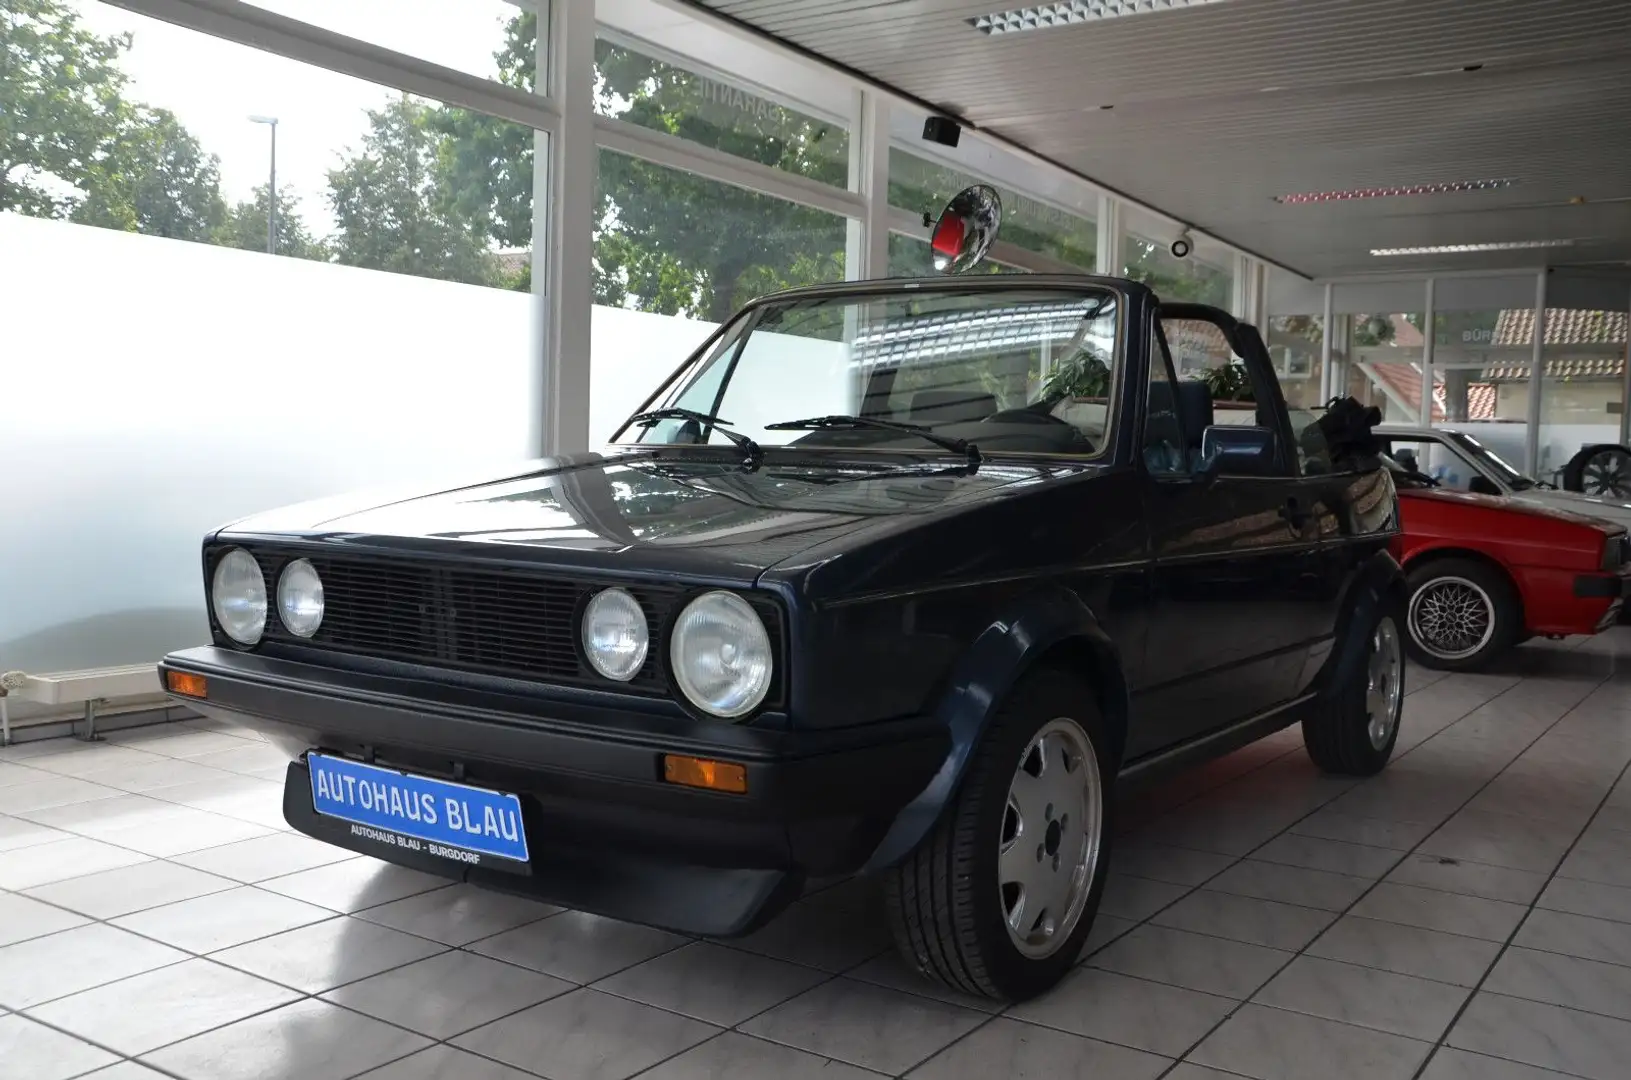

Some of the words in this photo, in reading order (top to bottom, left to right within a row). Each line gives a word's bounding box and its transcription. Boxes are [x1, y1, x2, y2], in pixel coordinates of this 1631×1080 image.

[318, 769, 438, 824] AUTOHAUS
[445, 798, 519, 842] BLAU
[351, 824, 396, 844] AUTOHAUS
[397, 836, 420, 850] BLAU
[429, 844, 480, 864] BURGDORF
